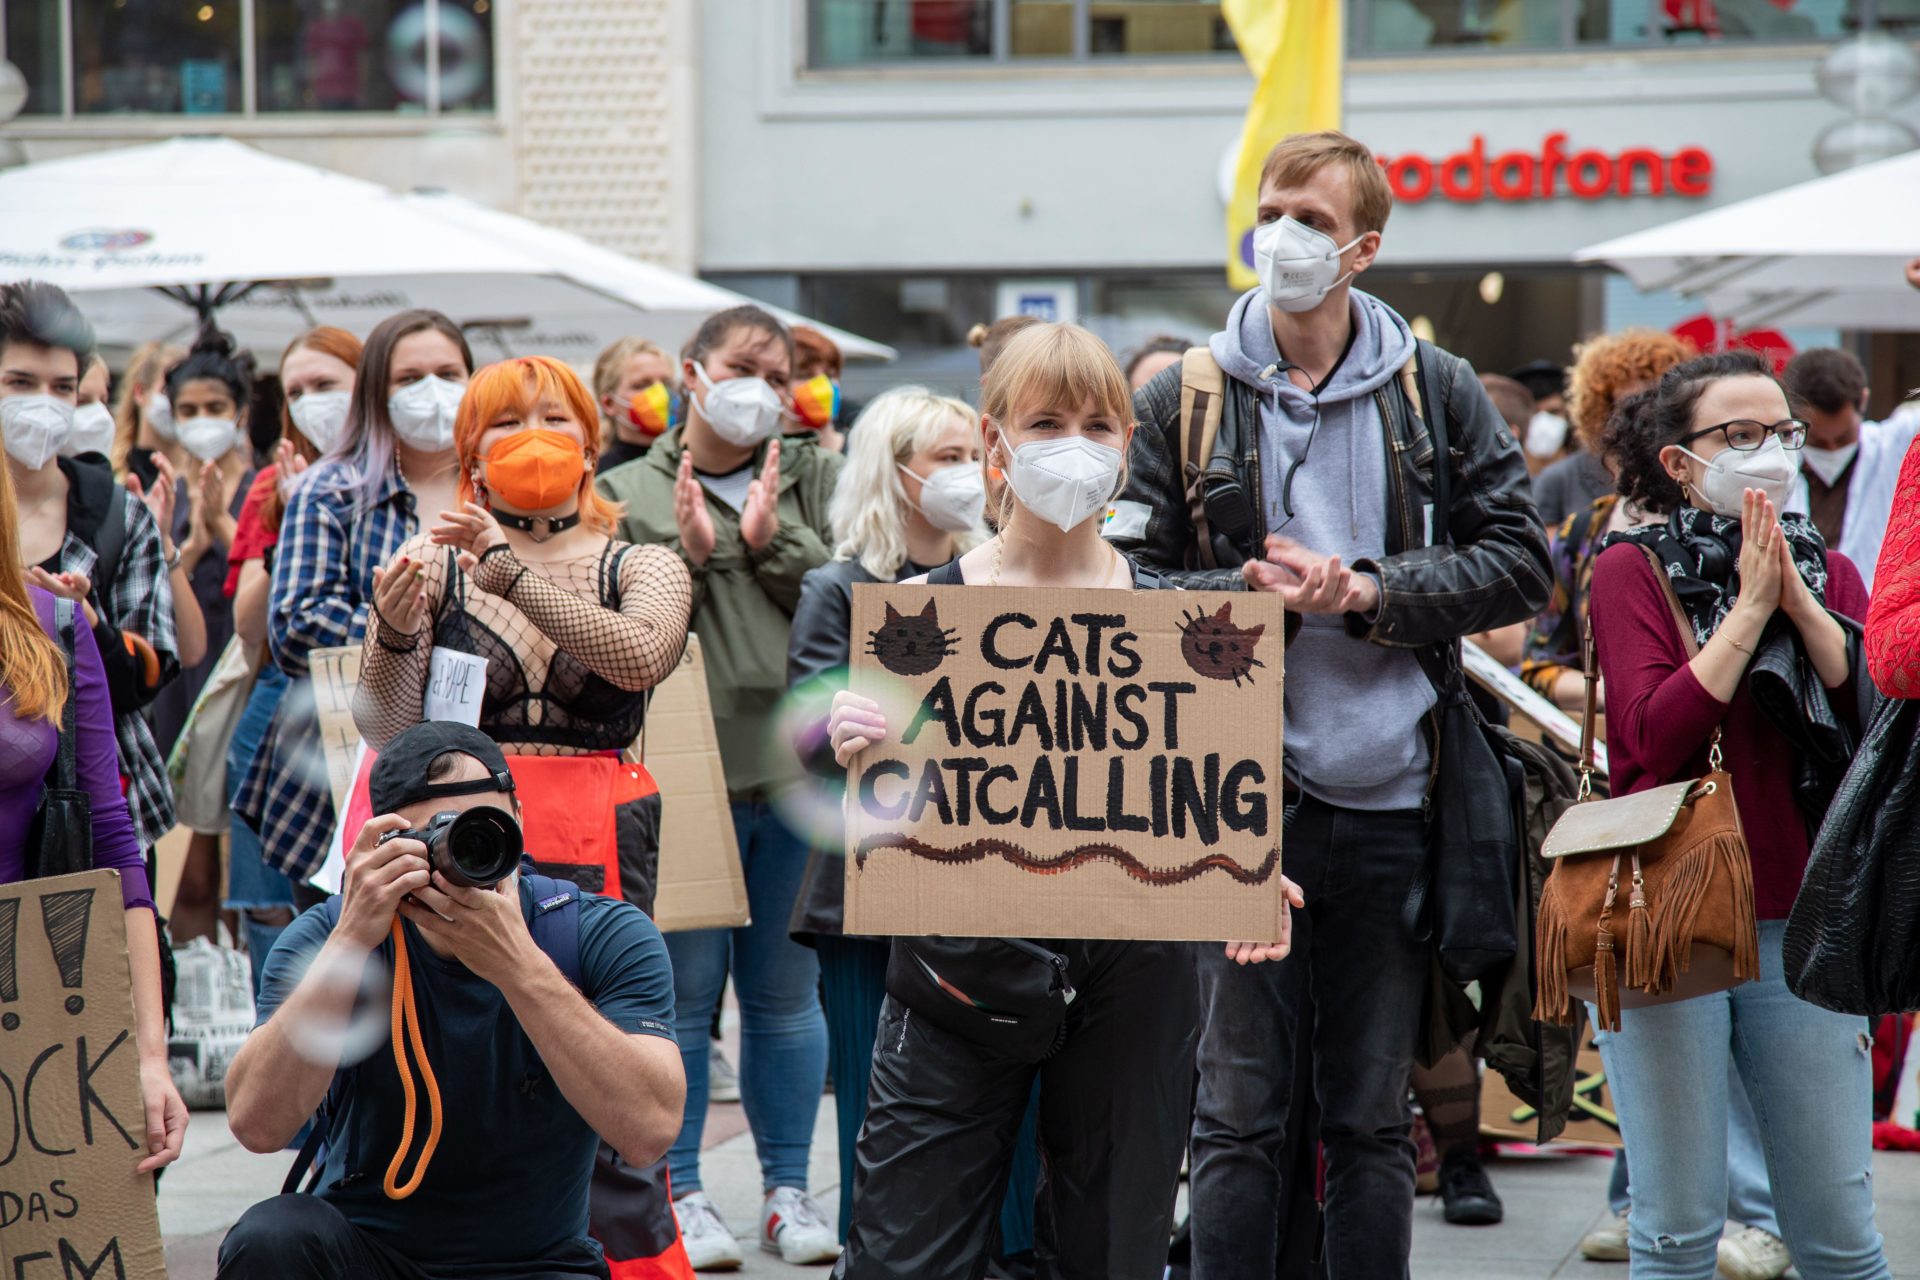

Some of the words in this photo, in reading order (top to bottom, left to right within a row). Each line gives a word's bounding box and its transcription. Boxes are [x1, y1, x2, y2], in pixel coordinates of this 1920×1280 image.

[1376, 132, 1713, 203] odafone
[901, 676, 1196, 752] AGAINST
[858, 752, 1268, 846] CATCALLING
[0, 1180, 79, 1229] DAS
